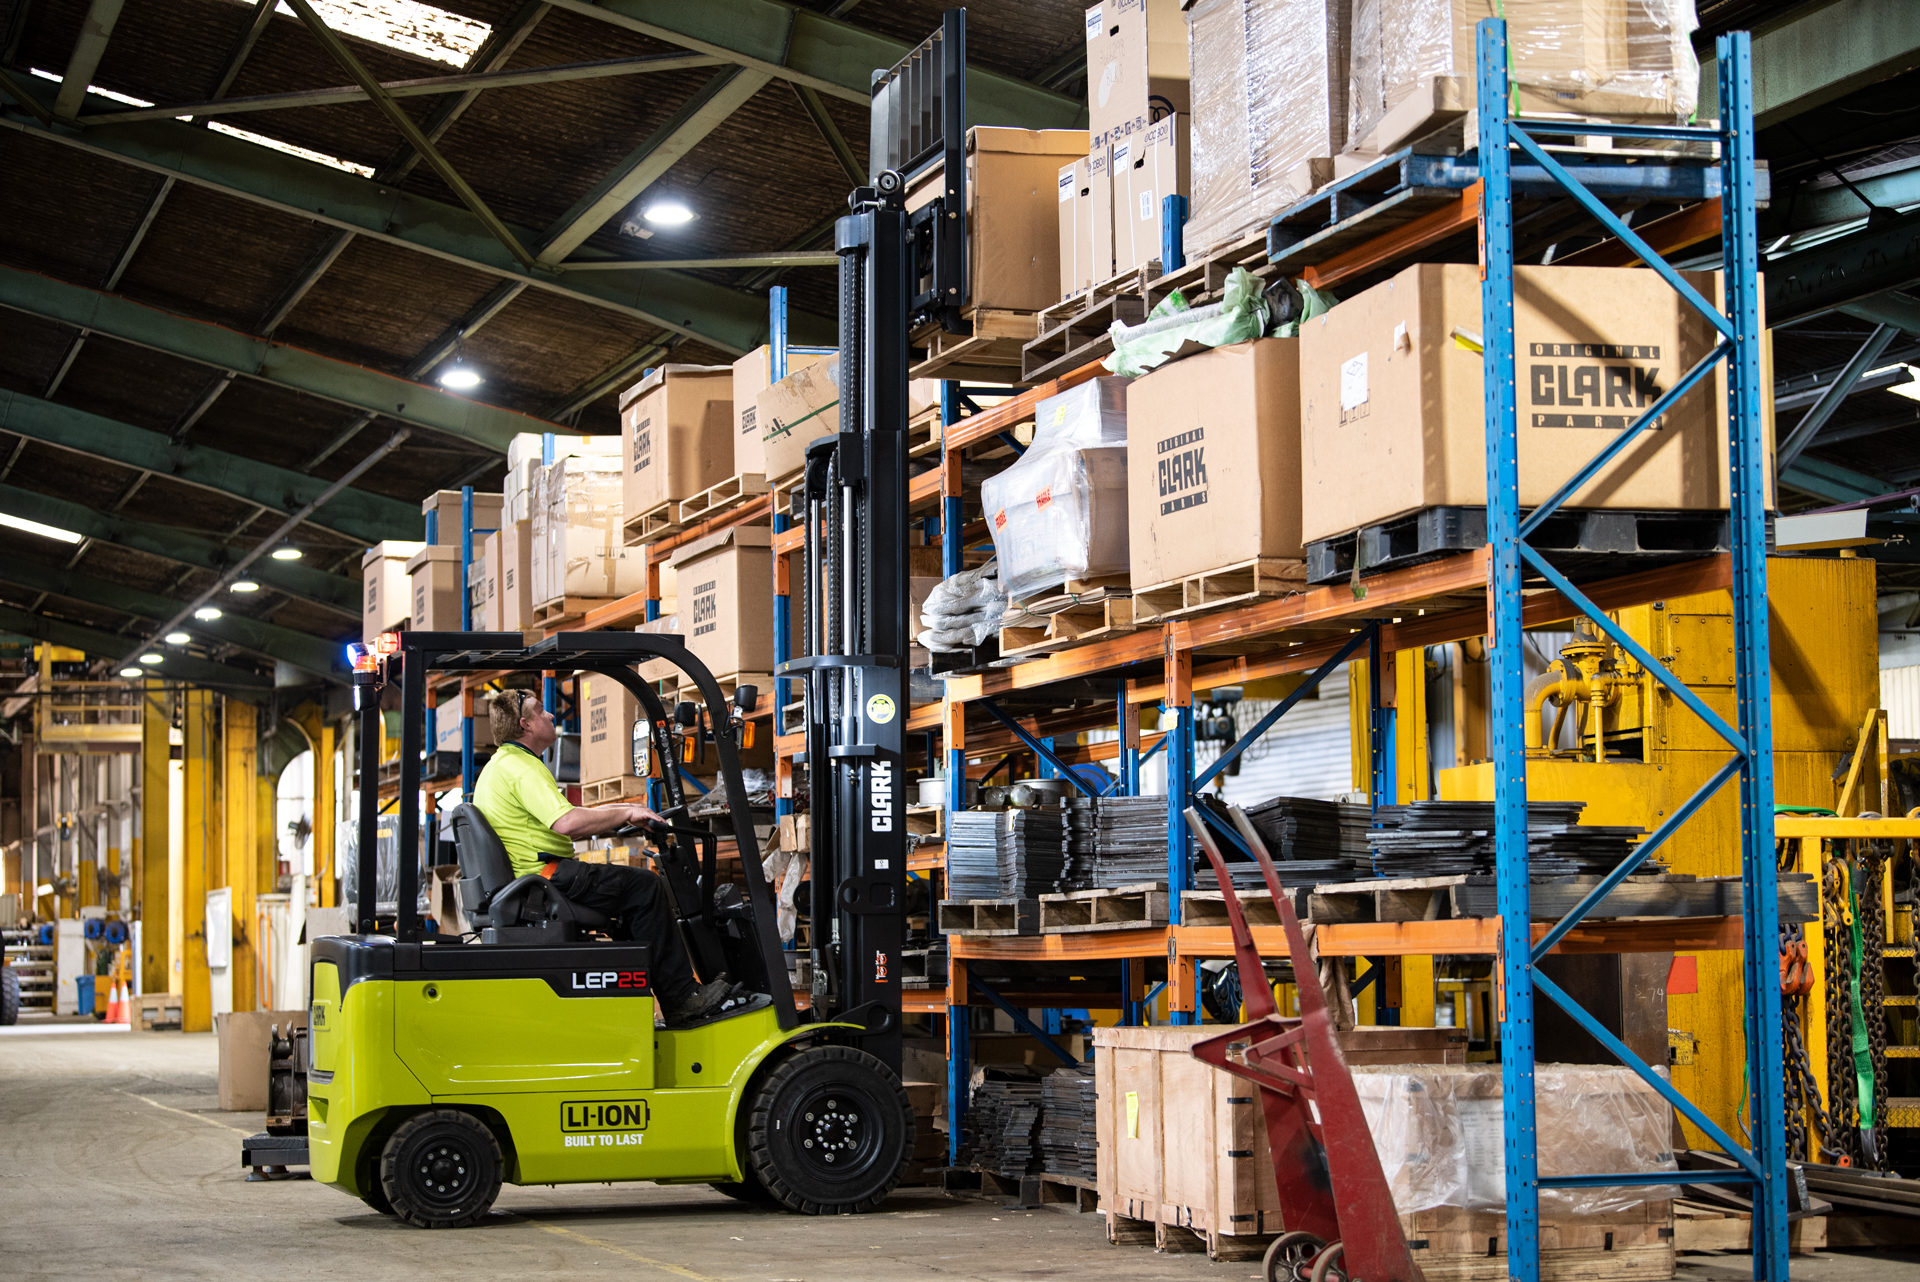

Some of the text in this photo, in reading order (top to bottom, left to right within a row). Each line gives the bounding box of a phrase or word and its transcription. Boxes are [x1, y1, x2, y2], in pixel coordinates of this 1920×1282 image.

[1535, 344, 1656, 359] ORIGINAL
[1530, 365, 1661, 408] CLARK
[1537, 414, 1657, 430] PARTS
[1158, 428, 1203, 453] ORIGINAL
[1158, 447, 1207, 497] CLARK
[1161, 491, 1206, 515] PARTS
[693, 593, 717, 624] CLARK
[870, 760, 892, 832] CLARK
[572, 971, 647, 989] LEP25
[568, 1104, 641, 1127] LI-ION
[564, 1133, 644, 1147] BUILT TO LAST
